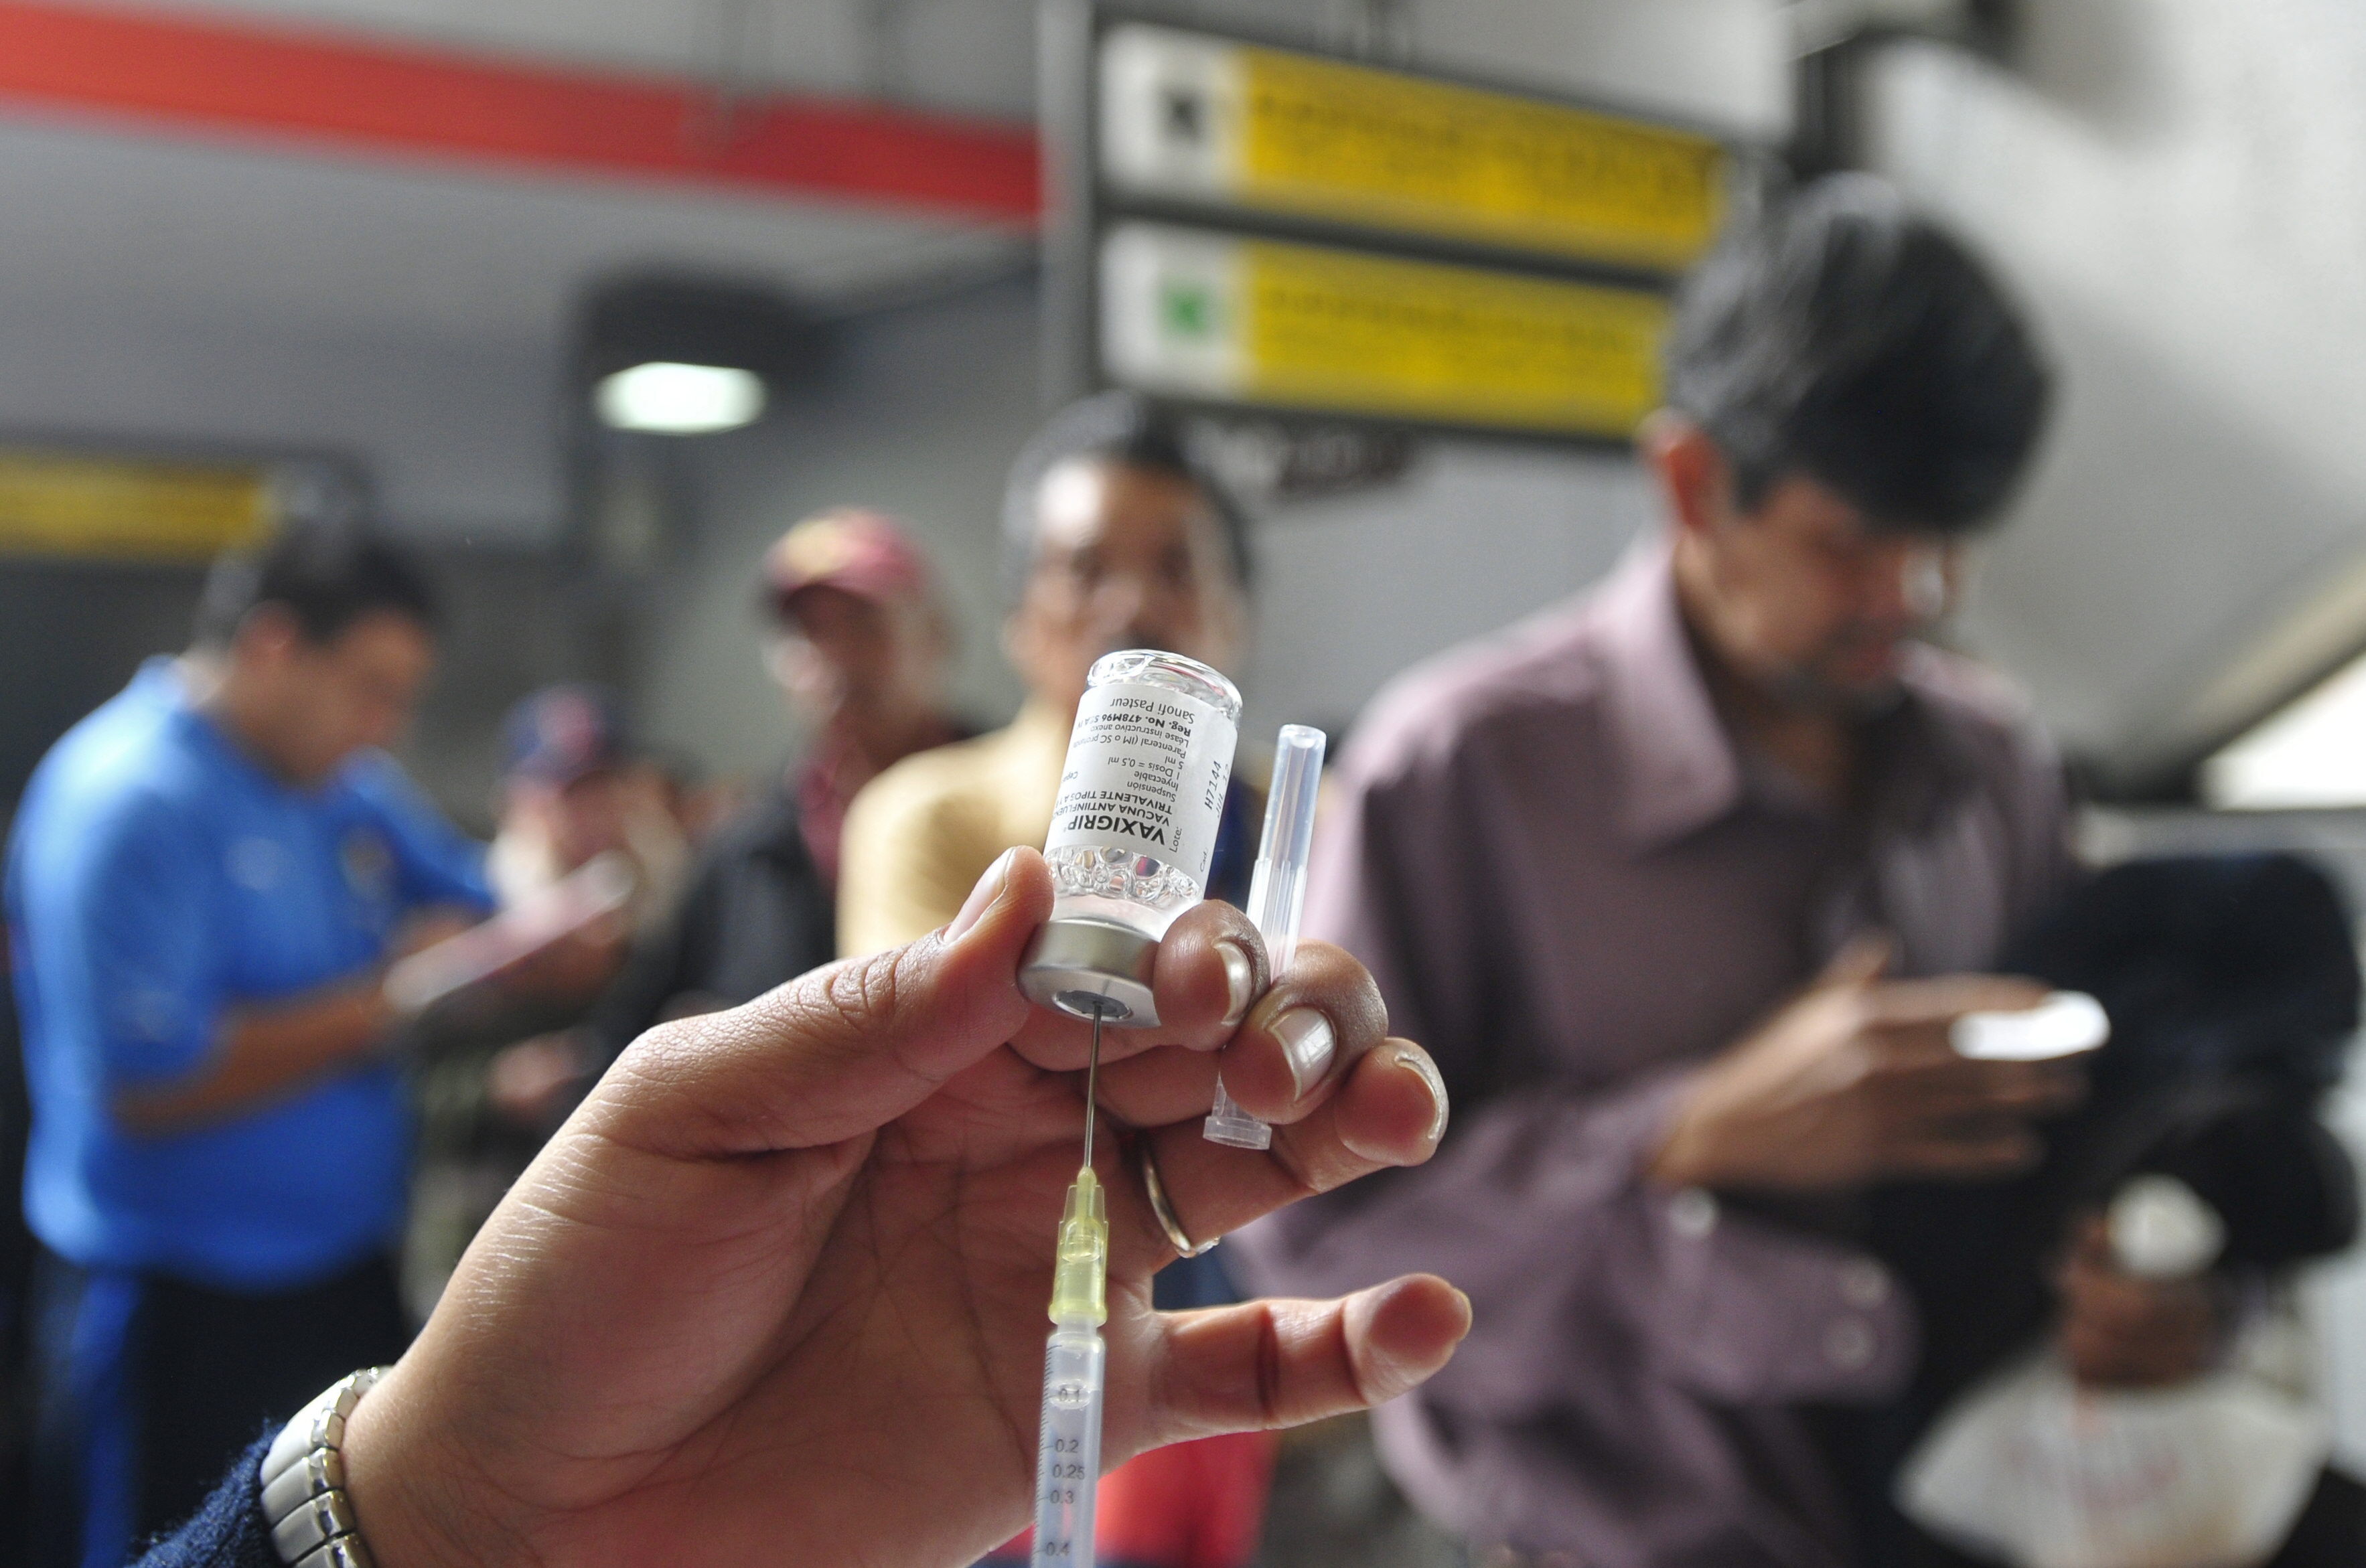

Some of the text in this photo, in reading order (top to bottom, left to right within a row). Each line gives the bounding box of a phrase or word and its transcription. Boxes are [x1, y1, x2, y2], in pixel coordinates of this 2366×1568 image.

[1102, 713, 1142, 723] 478M96
[1110, 698, 1195, 724] Sanofi Pasteur
[1146, 716, 1165, 728] No.
[1169, 721, 1191, 736] Reg.
[1115, 724, 1162, 738] instructivo
[1100, 735, 1112, 743] SC
[1123, 735, 1138, 744] (IM
[1165, 732, 1189, 748] Léase
[1140, 738, 1186, 759] Parenteral
[1149, 763, 1173, 777] Dosis
[1165, 756, 1184, 769] 5 ml
[1134, 771, 1179, 791] Inyectable
[1070, 791, 1097, 801] TIPOS
[1126, 781, 1176, 802] Suspensión
[1100, 791, 1172, 815] TRIVALENTE
[1169, 761, 1221, 853] Lote: H7144
[1119, 805, 1169, 826] VACUNA
[1055, 1439, 1079, 1453] 0.2
[1052, 1464, 1086, 1480] 0.25
[1050, 1490, 1074, 1504] 0.3
[1045, 1542, 1070, 1557] 0.4
